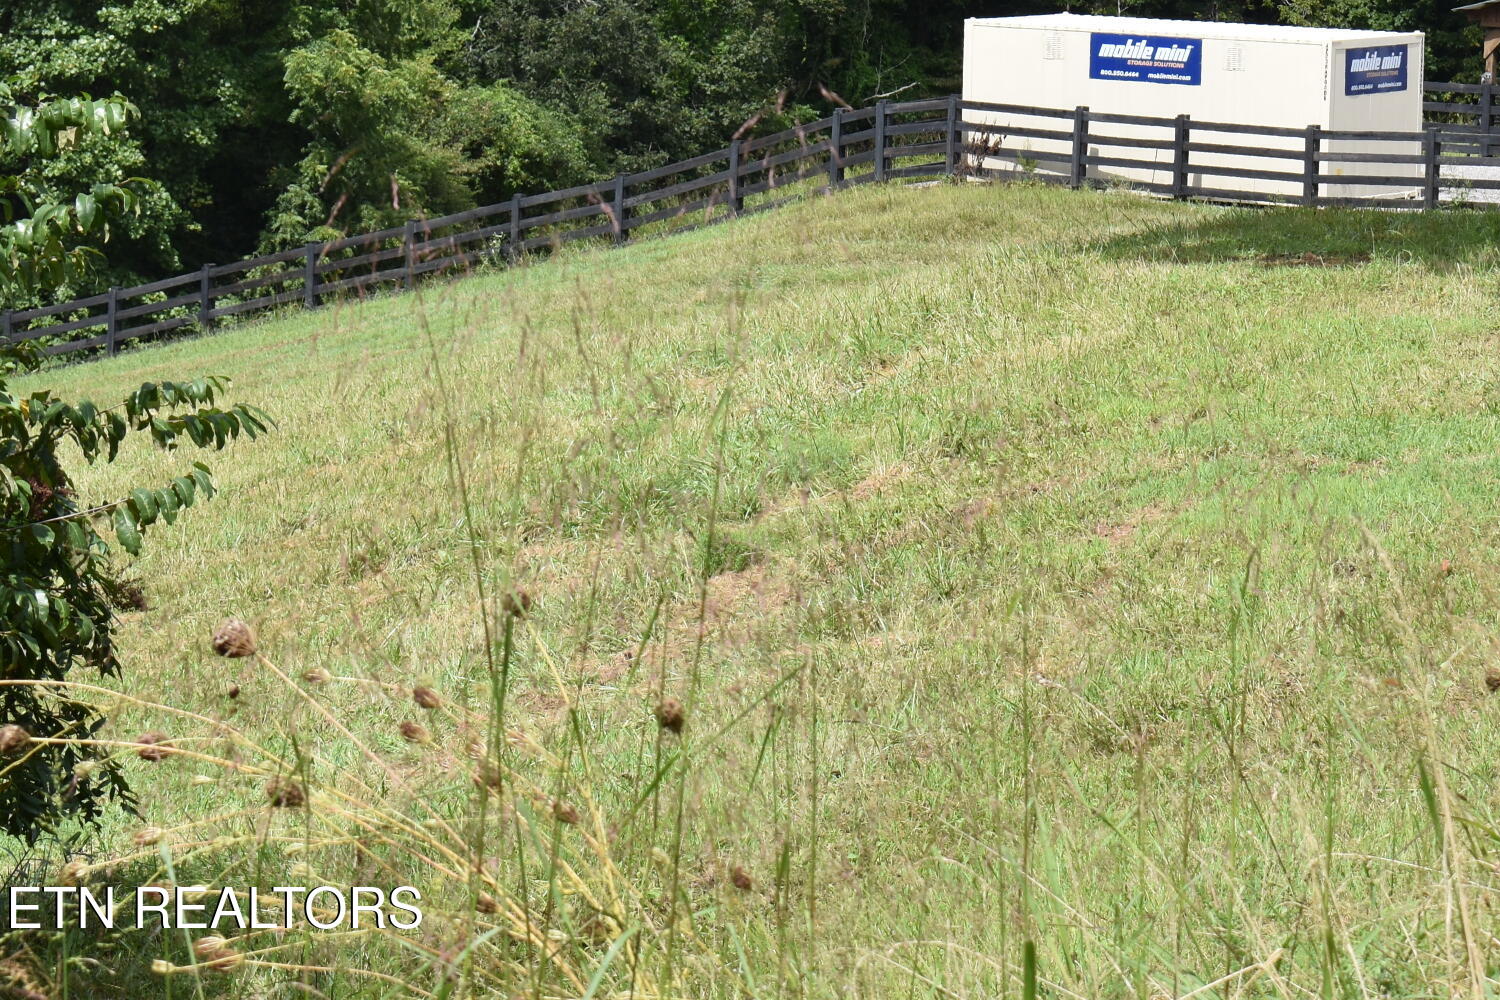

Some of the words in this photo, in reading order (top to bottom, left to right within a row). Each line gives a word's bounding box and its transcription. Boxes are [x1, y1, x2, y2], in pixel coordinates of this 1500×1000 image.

[1098, 39, 1154, 60] mobile
[1154, 44, 1193, 62] mini
[1350, 51, 1381, 72] mobile
[1381, 52, 1402, 70] mini
